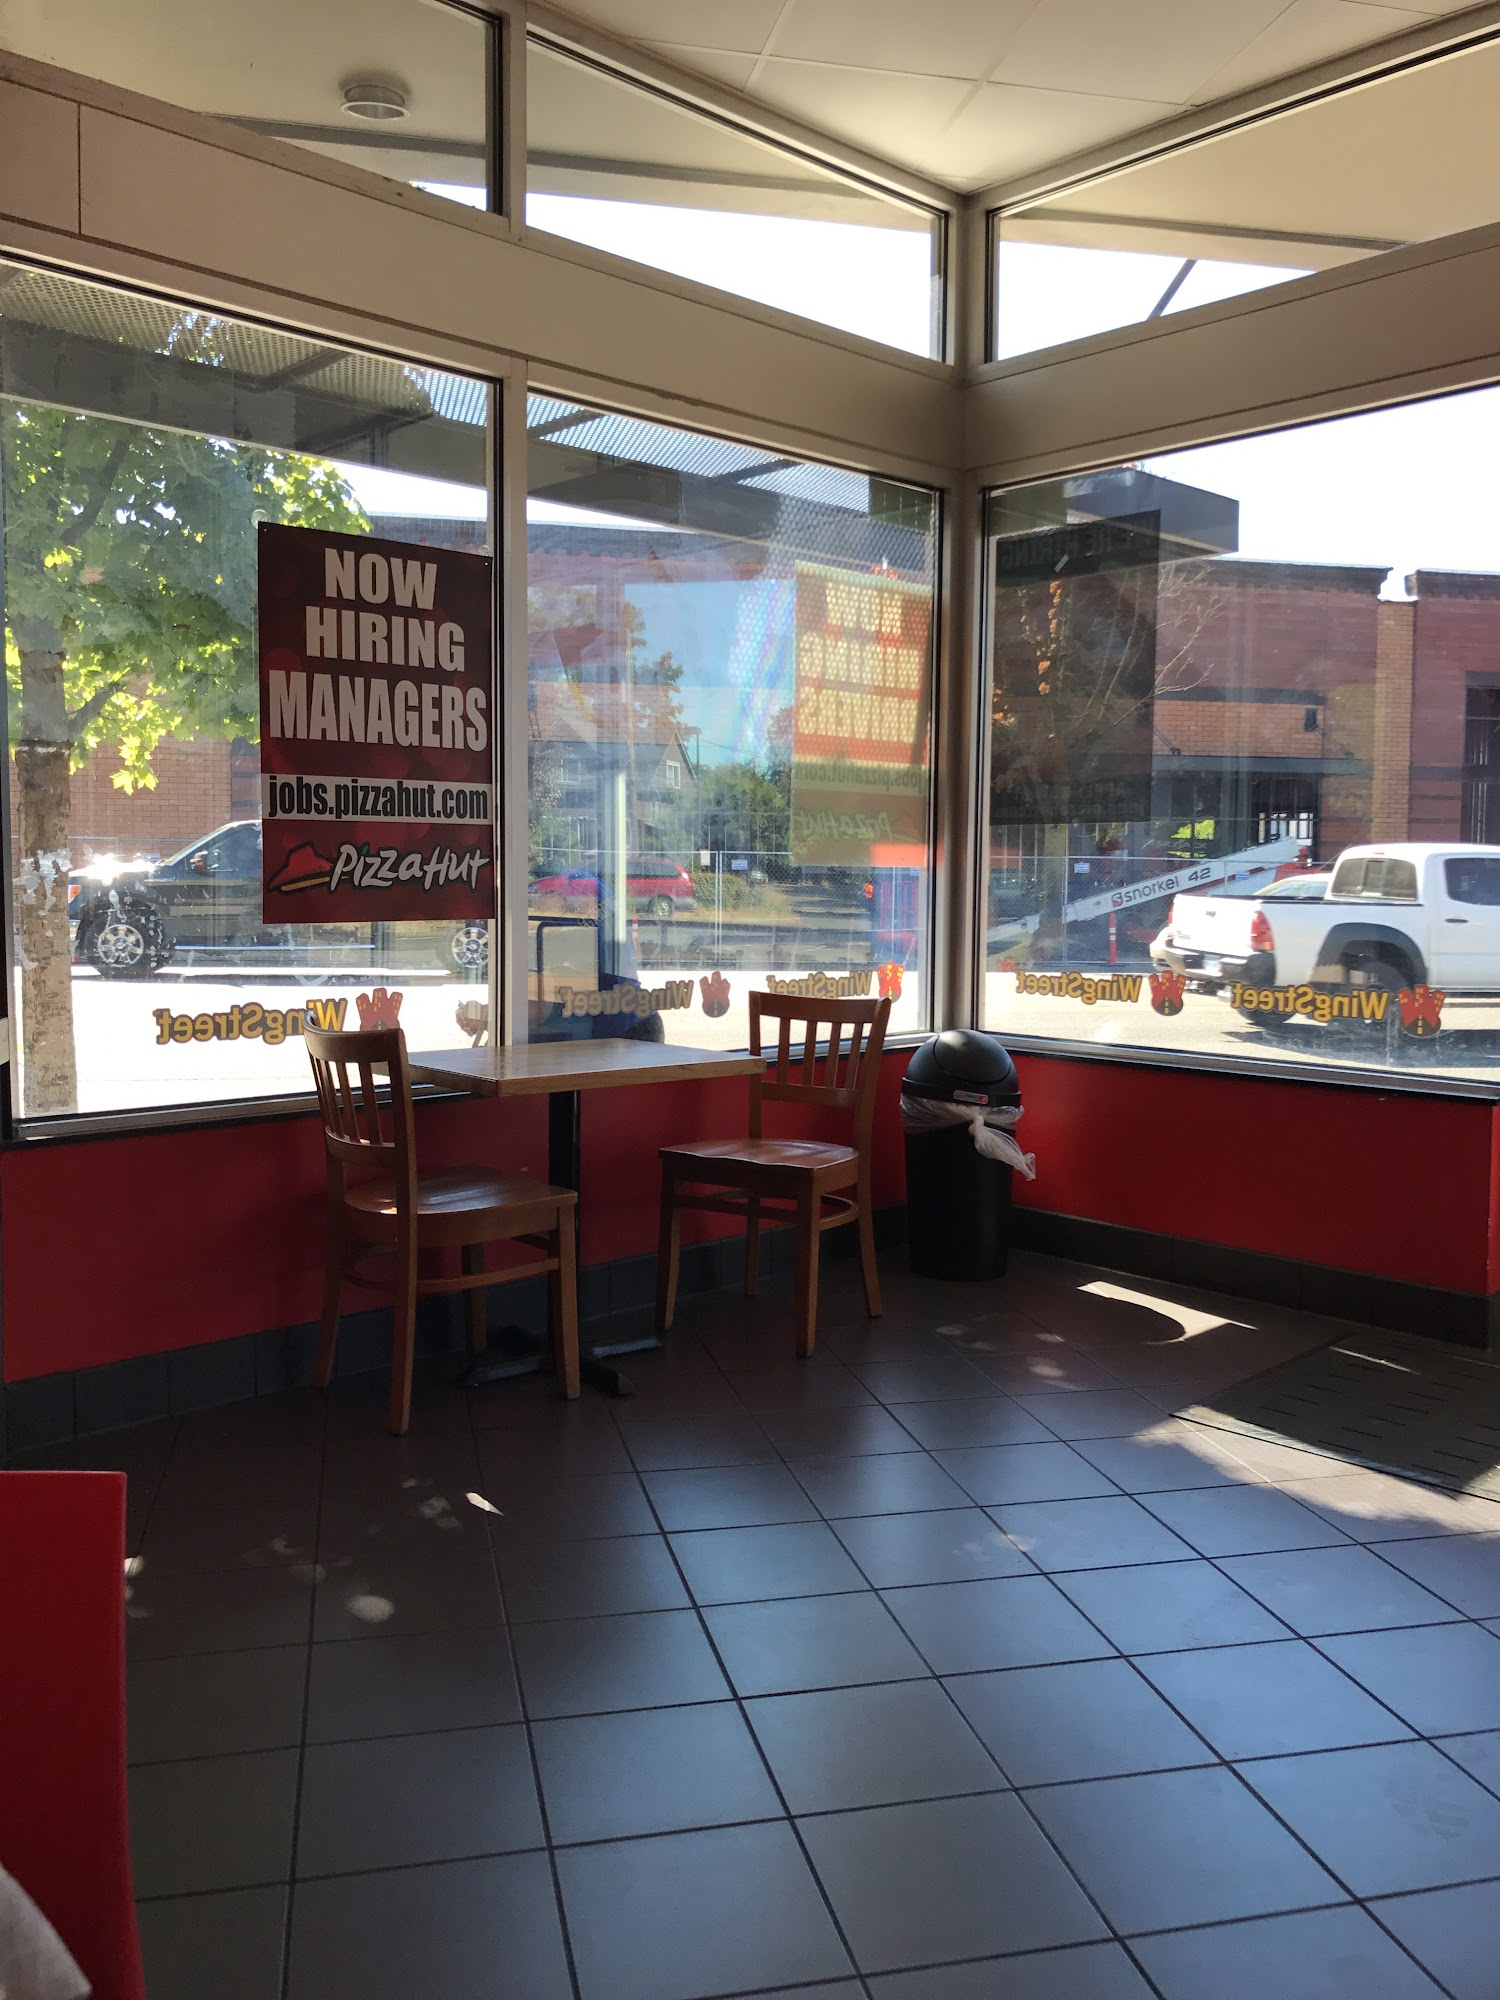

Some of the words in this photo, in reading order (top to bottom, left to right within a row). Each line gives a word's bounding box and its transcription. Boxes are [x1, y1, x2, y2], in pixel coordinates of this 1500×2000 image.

[325, 548, 438, 610] NOW
[306, 605, 465, 672] HIRING
[268, 669, 488, 751] MANAGERS
[269, 775, 488, 820] jobs.pizzahut.com
[330, 844, 423, 891] Pizza
[423, 846, 491, 890] Hut
[1188, 867, 1212, 881] 42
